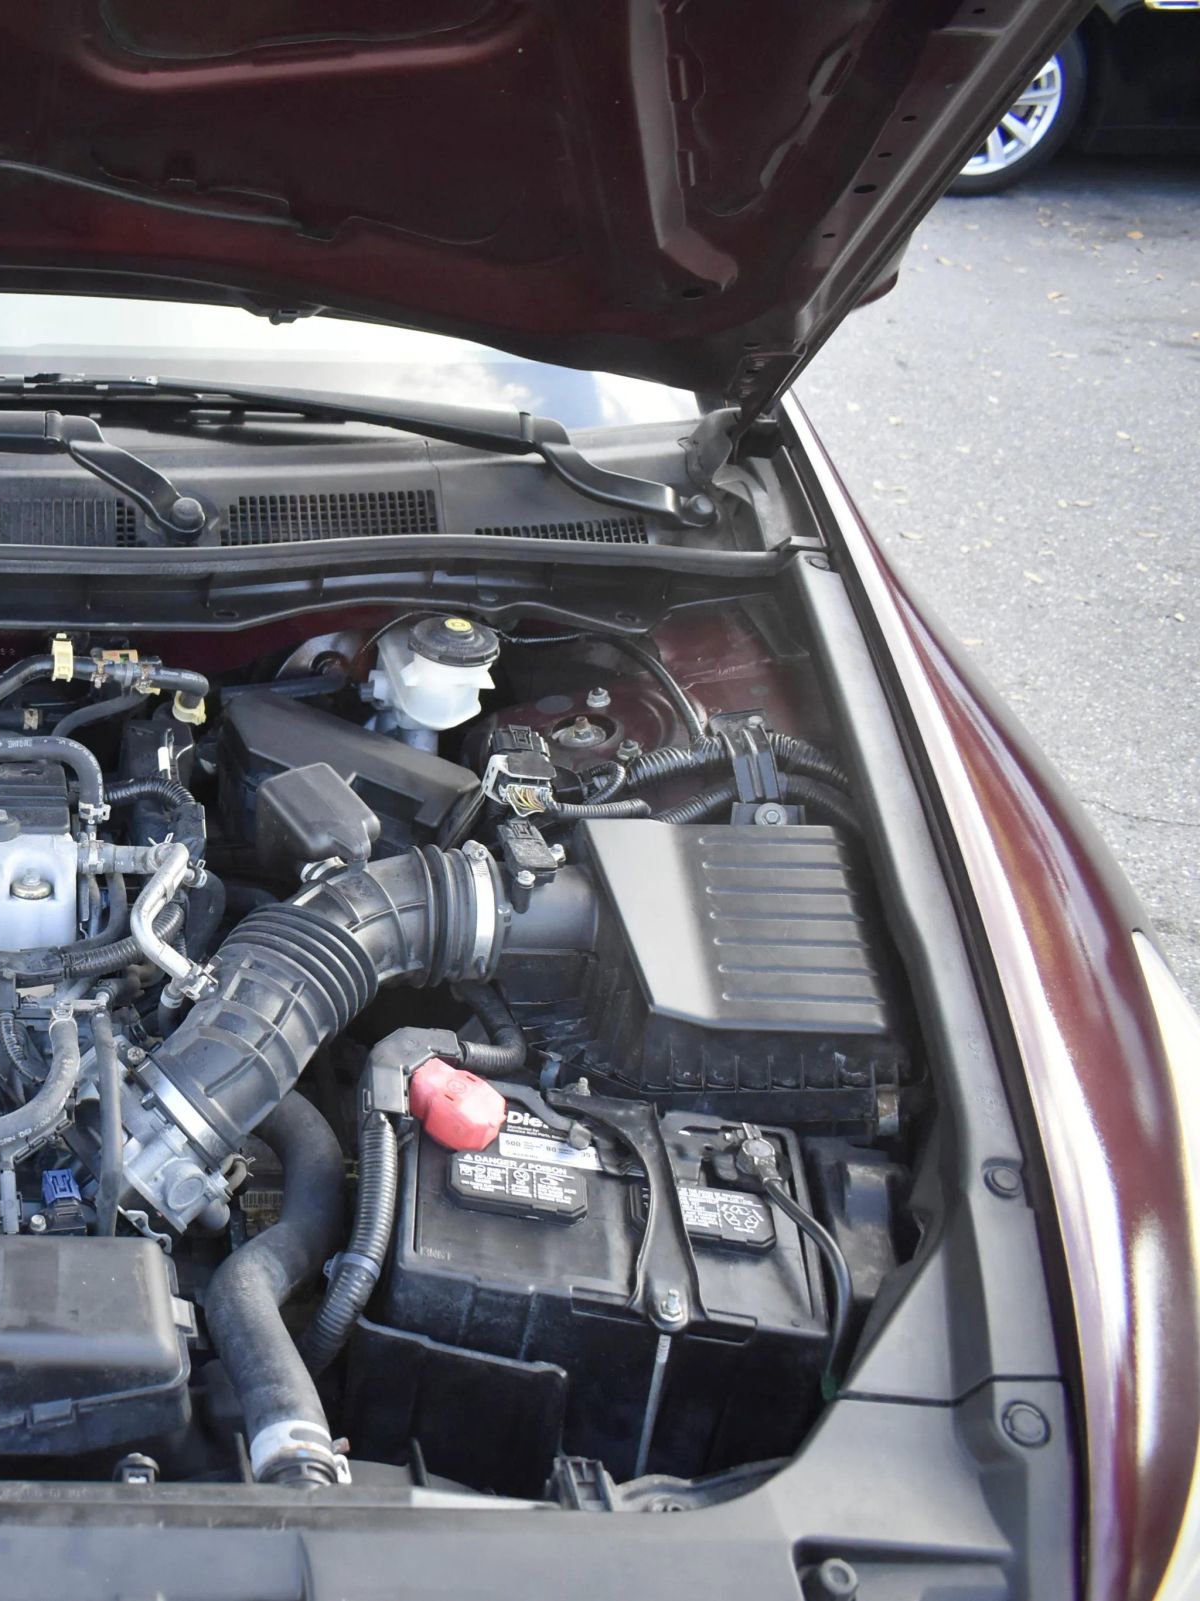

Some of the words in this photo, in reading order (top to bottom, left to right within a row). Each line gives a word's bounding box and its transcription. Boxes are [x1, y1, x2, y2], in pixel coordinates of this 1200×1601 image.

[506, 1110, 550, 1129] Die
[474, 1155, 518, 1168] DANGER
[528, 1163, 568, 1175] POISON
